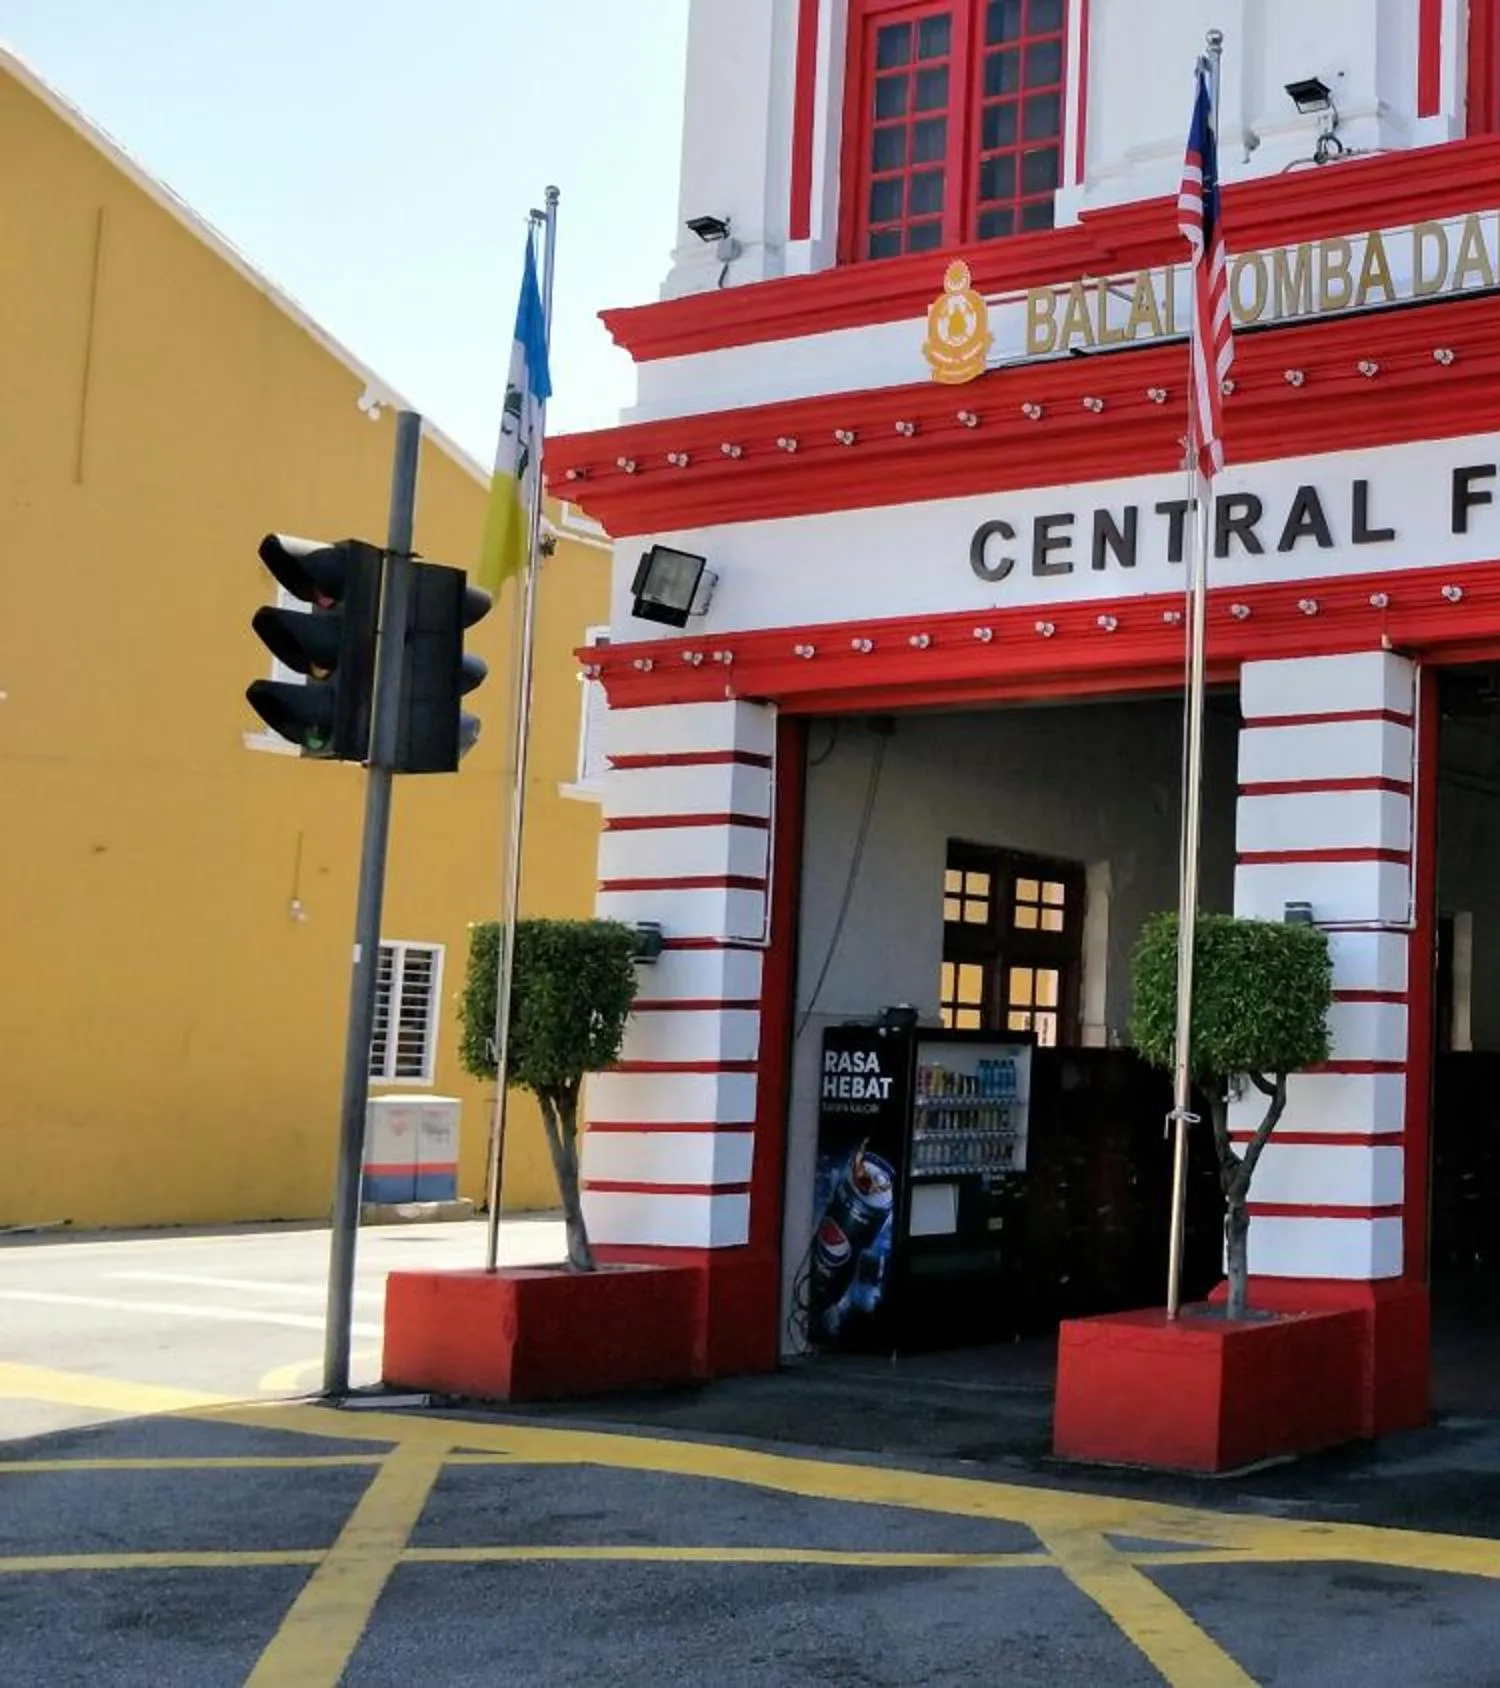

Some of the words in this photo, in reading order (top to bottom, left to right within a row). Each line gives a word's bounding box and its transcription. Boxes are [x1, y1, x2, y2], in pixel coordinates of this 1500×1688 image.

[1026, 263, 1175, 354] BALAI
[1198, 231, 1396, 328] OMBA
[969, 480, 1396, 581] CENTRAL
[823, 1075, 893, 1099] HEBAT
[825, 1050, 880, 1073] RASA
